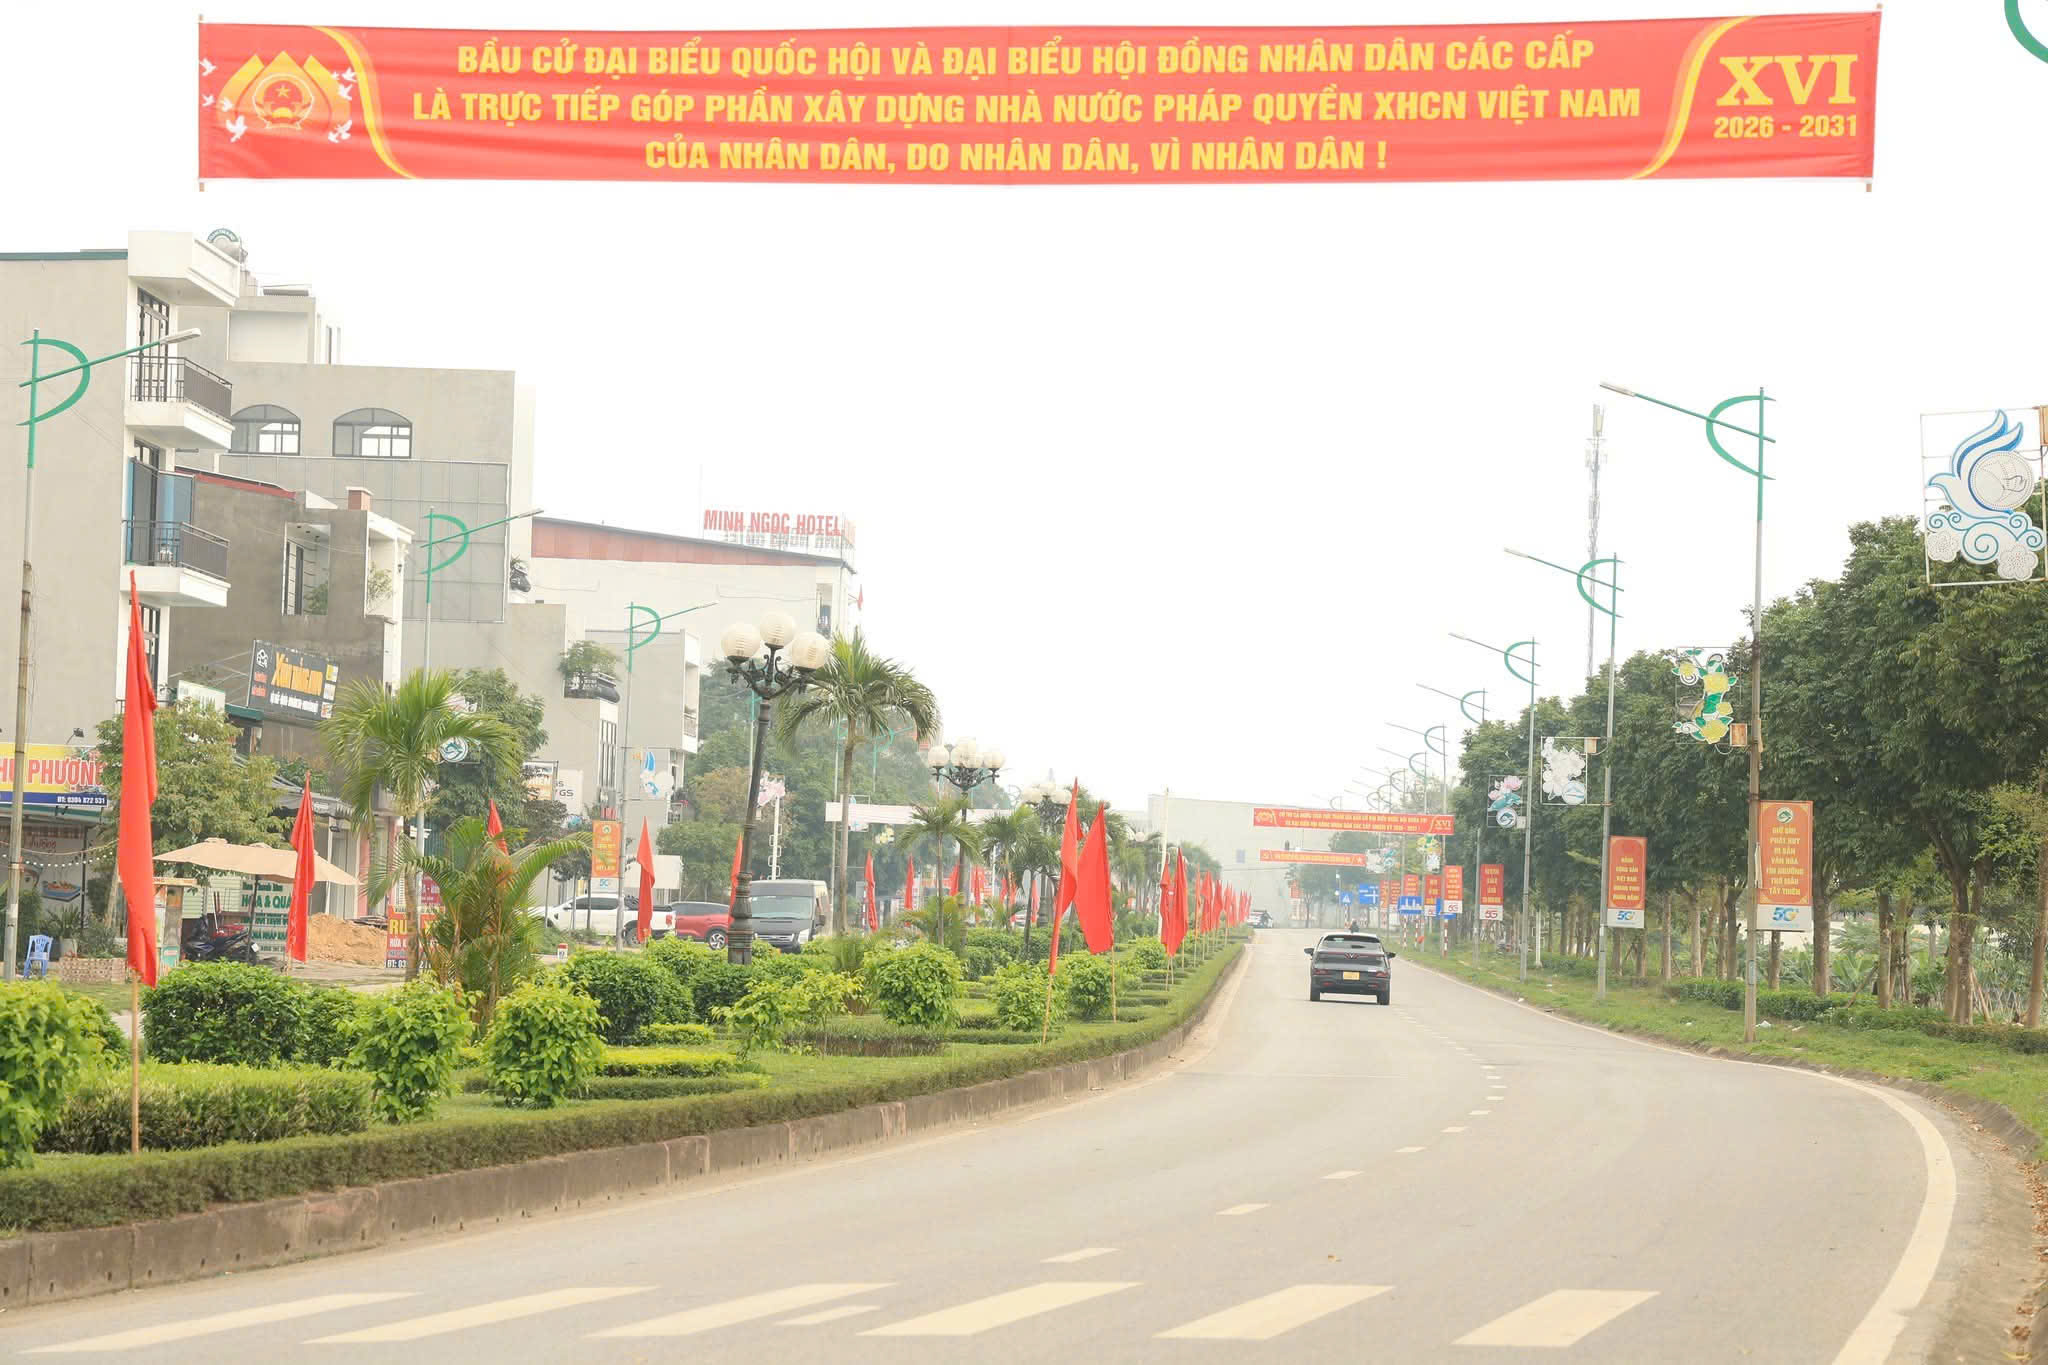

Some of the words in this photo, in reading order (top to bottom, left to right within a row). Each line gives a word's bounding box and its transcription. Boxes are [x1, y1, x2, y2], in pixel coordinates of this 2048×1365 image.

[458, 36, 522, 73] BẦU
[531, 36, 581, 74] CỬ
[582, 46, 638, 81] ĐẠI
[647, 35, 721, 75] BIỂU
[731, 36, 817, 79] QUỐC
[827, 42, 881, 81] HỘI
[891, 43, 933, 76] VÀ
[941, 46, 997, 81] ĐẠI
[1007, 34, 1082, 75] BIỂU
[1092, 38, 1147, 81] HỘI
[1154, 36, 1249, 74] ĐỒNG
[1259, 38, 1354, 73] NHÂN
[1364, 35, 1435, 72] DÂN
[1445, 36, 1513, 71] CÁC
[1525, 30, 1593, 70] CẤP
[1715, 54, 1859, 107] XVI
[413, 87, 452, 121] LÀ
[460, 91, 542, 128] TRỰC
[551, 87, 621, 121] TIẾP
[631, 88, 695, 122] GÓP
[704, 86, 793, 123] PHẦN
[803, 89, 865, 124] XÂY
[876, 92, 965, 129] DỰNG
[975, 88, 1043, 124] NHÀ
[1053, 88, 1143, 124] NƯỚC
[1153, 87, 1243, 123] PHÁP
[1252, 83, 1363, 125] QUYỀN
[1373, 90, 1467, 121] XHCN
[1476, 83, 1550, 125] VIỆT
[1559, 87, 1641, 118] NAM
[1714, 114, 1775, 139] 2026
[1781, 124, 1793, 132] -
[1798, 113, 1857, 138] 2031
[645, 132, 710, 169] CỦA
[719, 136, 811, 169] NHÂN
[820, 137, 896, 175] DÂN,
[906, 143, 950, 171] DO
[959, 136, 1052, 172] NHÂN
[1061, 136, 1140, 174] DÂN,
[1149, 136, 1181, 171] VÌ
[1191, 135, 1285, 171] NHÂN
[1295, 135, 1365, 170] DÂN
[1377, 140, 1387, 169] !
[704, 509, 744, 532] MINH
[796, 514, 842, 536] HOTEL
